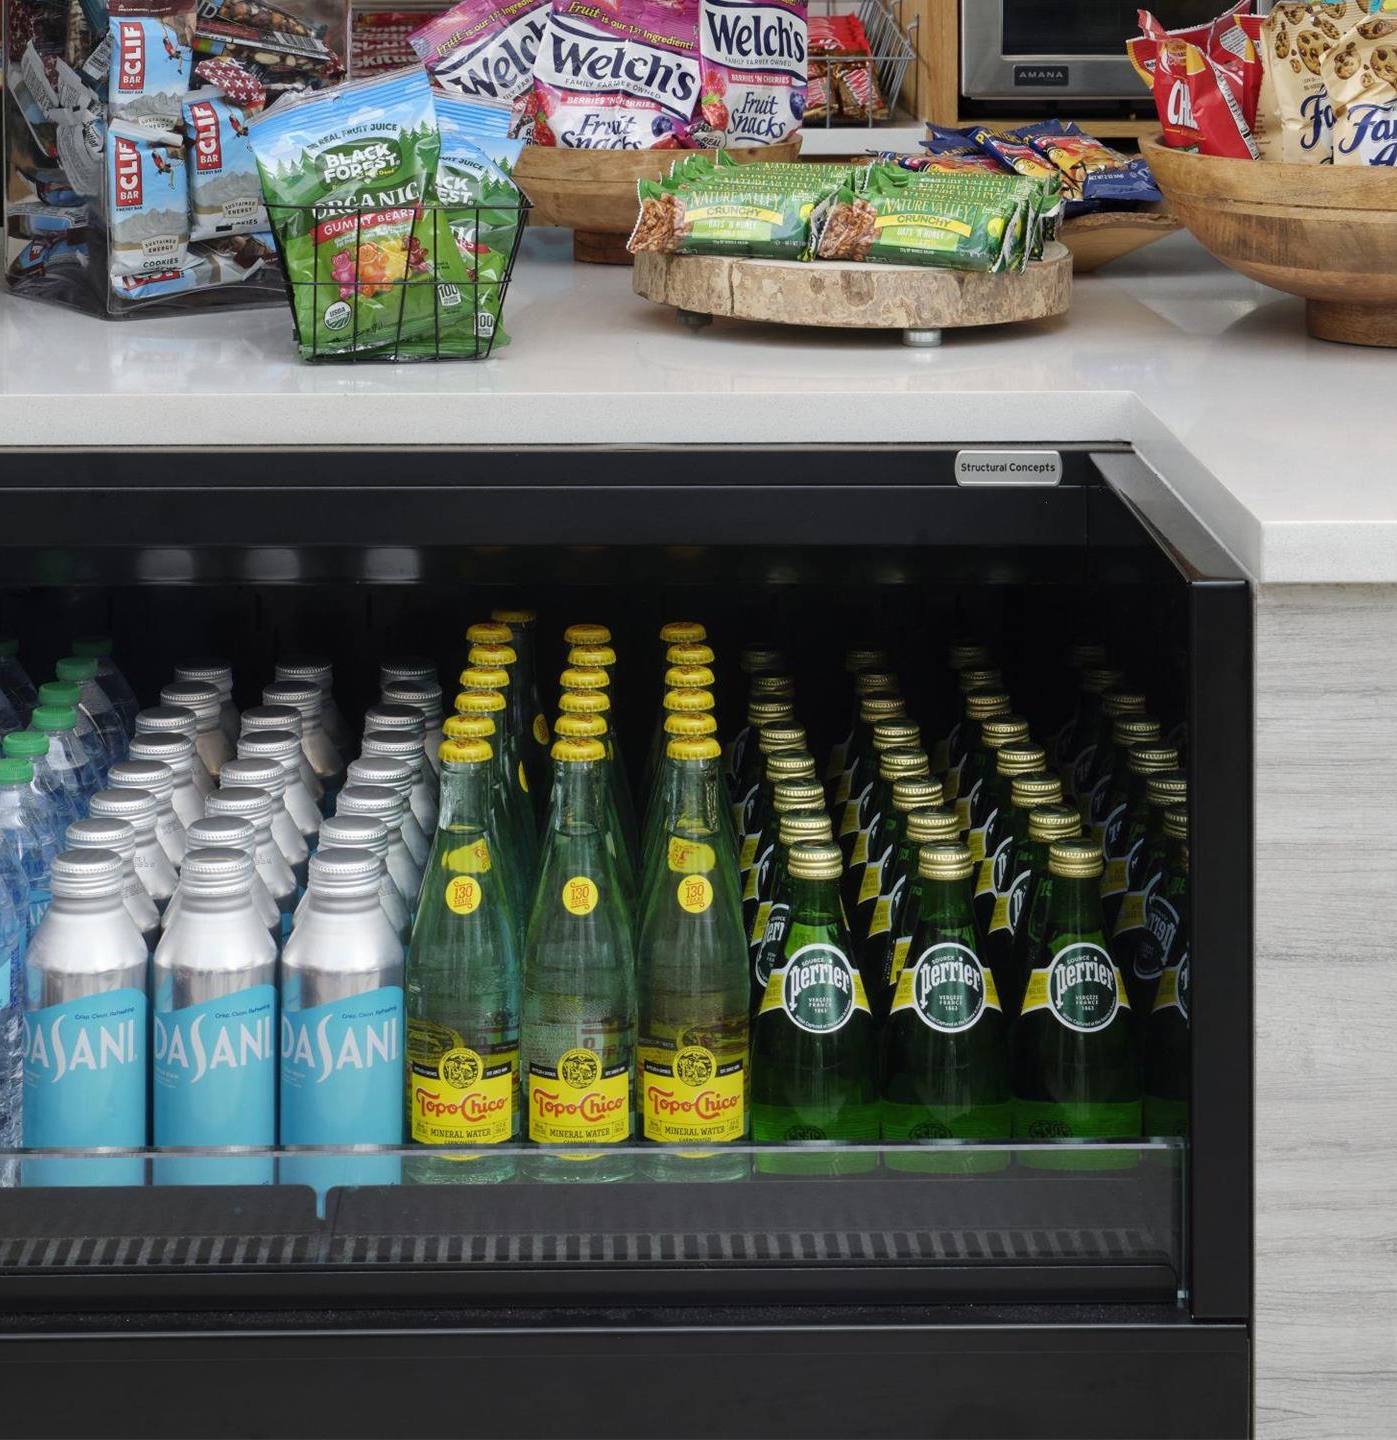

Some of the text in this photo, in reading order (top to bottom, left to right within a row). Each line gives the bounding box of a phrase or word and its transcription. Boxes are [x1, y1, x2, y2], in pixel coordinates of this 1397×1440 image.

[568, 0, 694, 50] Fruit is our Ingredient!
[703, 8, 806, 67] Welch's
[121, 25, 144, 75] CLIF
[549, 30, 697, 102] Welch's
[724, 56, 792, 68] FAMILY OWNED
[122, 74, 142, 85] BAR
[1018, 70, 1064, 80] AMANA
[564, 78, 662, 99] FAMILY OWNED
[566, 96, 606, 106] BERRIES
[740, 90, 779, 116] Fruit
[195, 108, 218, 156] CLIF
[369, 122, 399, 134] JUICE
[577, 113, 638, 137] Fruit
[726, 107, 788, 141] Snacks
[200, 154, 220, 164] BAR
[325, 142, 393, 168] BLACK
[118, 142, 140, 190] CLIF
[120, 190, 140, 201] BAR
[310, 180, 422, 221] ORGANIC
[690, 190, 783, 211] NATURE VALLEY
[706, 205, 763, 217] CRUNCHY
[881, 197, 972, 222] NATURE VALLEY
[323, 208, 415, 236] GUMMY BEARS
[896, 214, 953, 228] CRUNCHY
[142, 257, 180, 268] COOKIES
[438, 284, 459, 298] 100
[328, 306, 347, 317] USDA
[960, 462, 1056, 474] Structural Concepts
[454, 884, 474, 900] 130
[570, 886, 590, 900] 130
[684, 884, 705, 899] 130
[414, 1086, 510, 1124] Topo Chico
[532, 1086, 628, 1124] Topo Chico
[646, 1084, 742, 1123] Topo Chico
[429, 1126, 492, 1139] MINERAL WATER
[548, 1126, 610, 1139] MINERAL WATER
